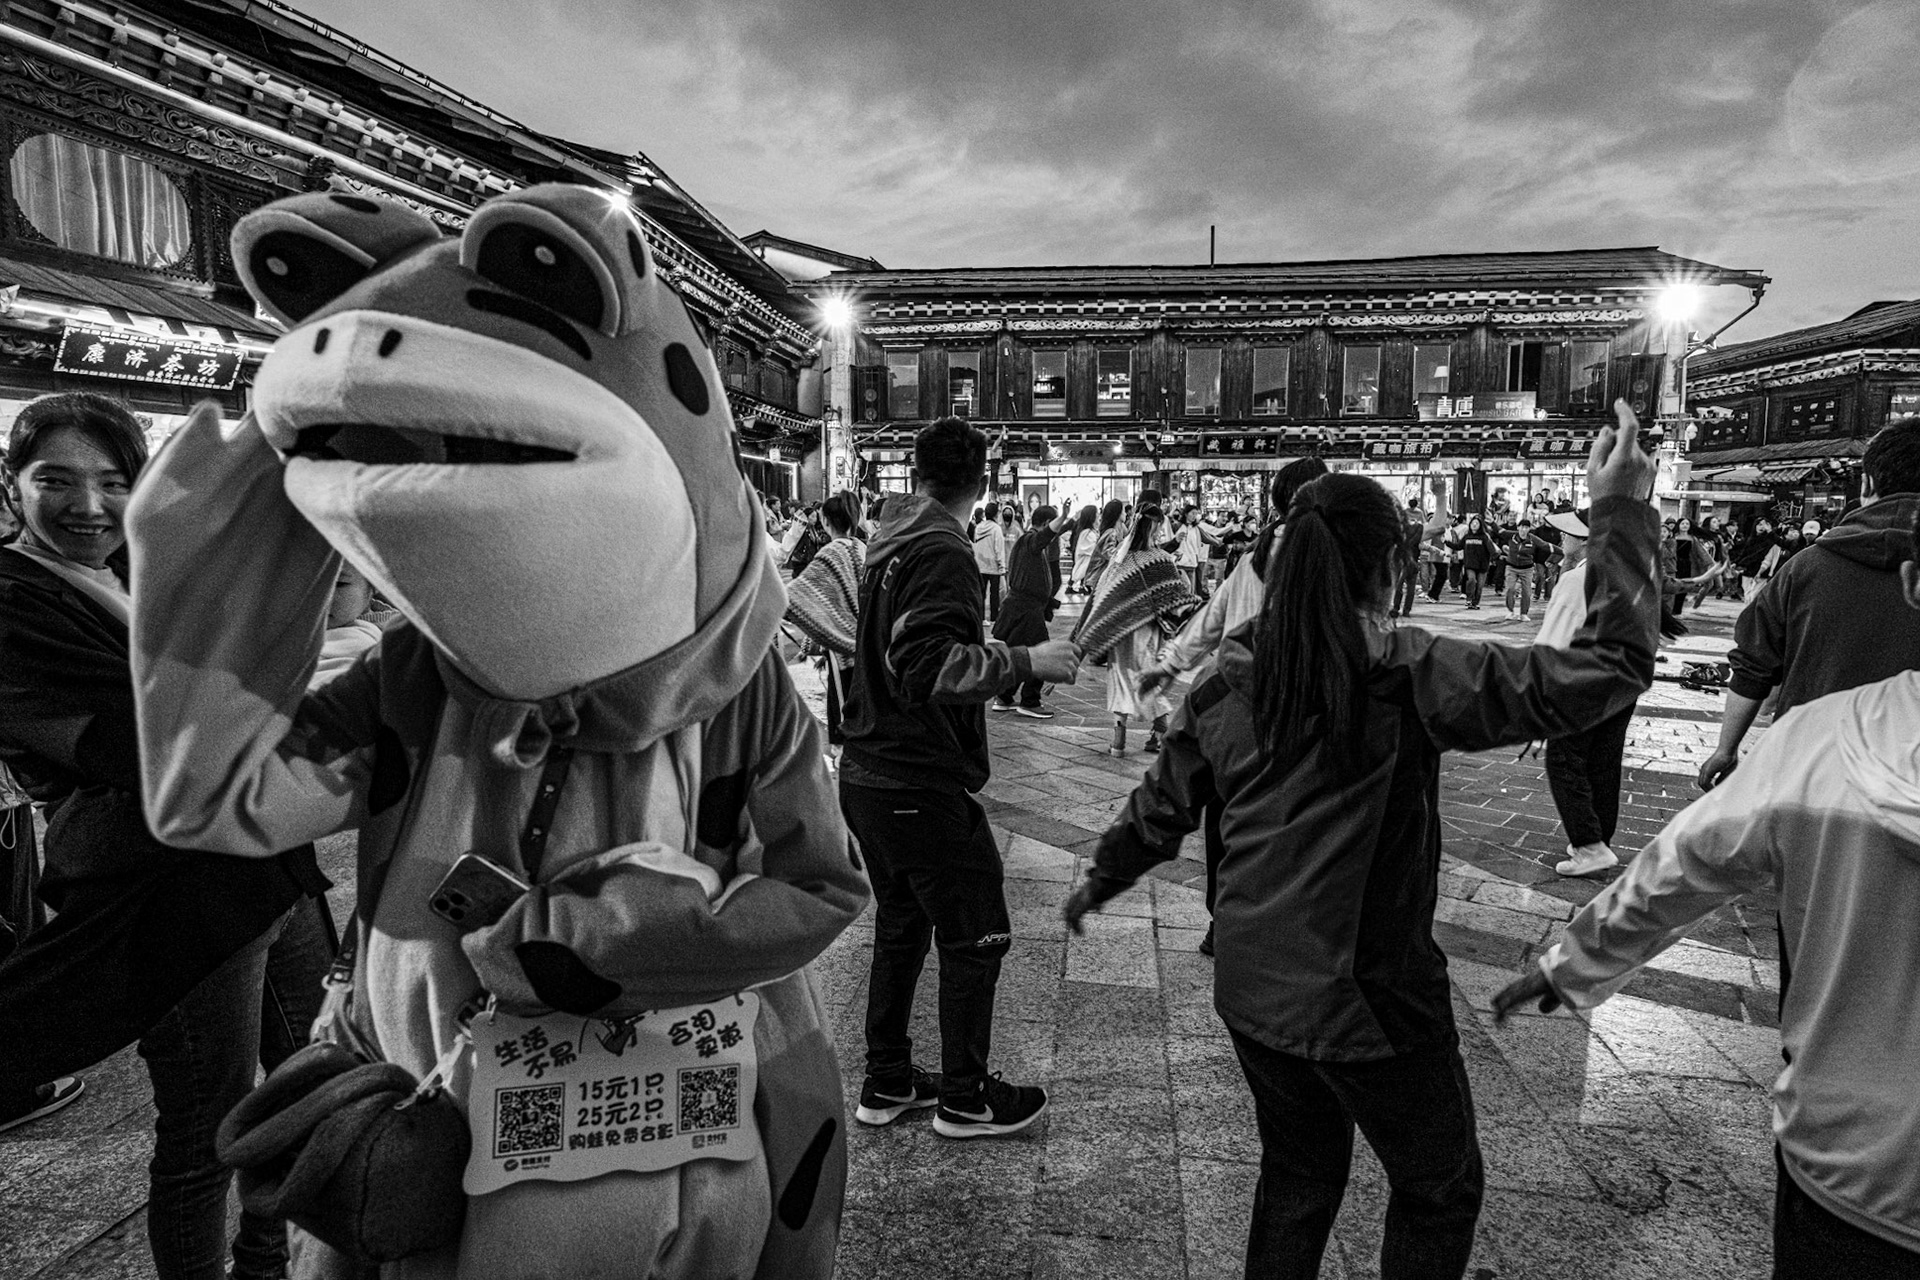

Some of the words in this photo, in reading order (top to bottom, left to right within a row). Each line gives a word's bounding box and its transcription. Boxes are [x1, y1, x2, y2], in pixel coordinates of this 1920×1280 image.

[81, 342, 221, 377] 康济茶坊
[1529, 439, 1592, 452] 藏咖服
[667, 1008, 716, 1047] 含泪
[494, 1024, 549, 1067] 生活
[523, 1040, 577, 1080] 不易
[578, 1072, 665, 1102] 15元1只
[577, 1098, 665, 1128] 25元2只
[568, 1123, 674, 1151] 购蛙免费合影
